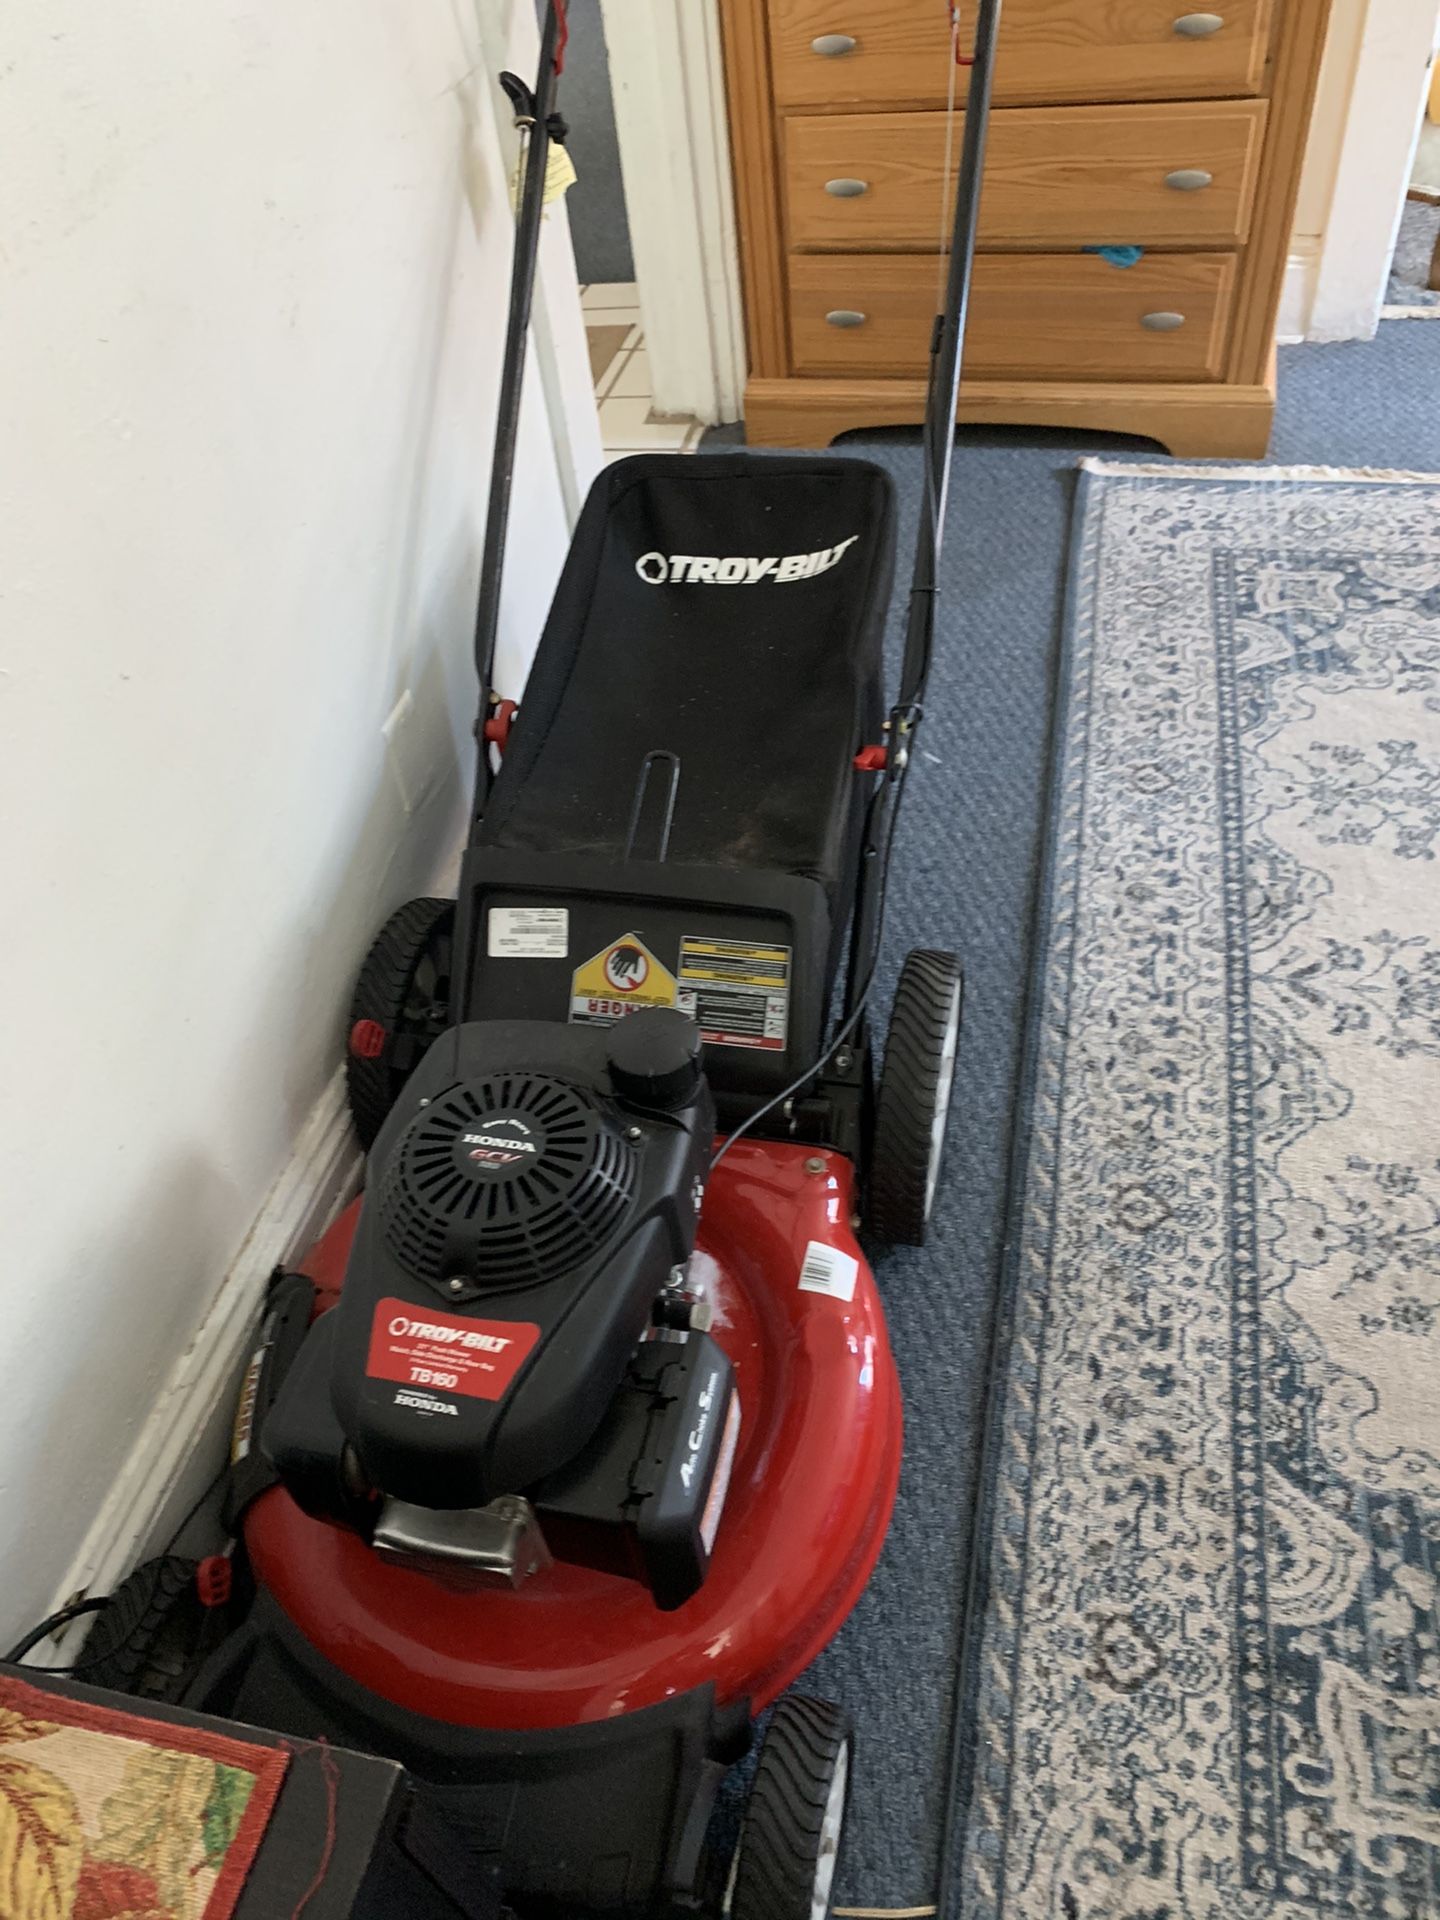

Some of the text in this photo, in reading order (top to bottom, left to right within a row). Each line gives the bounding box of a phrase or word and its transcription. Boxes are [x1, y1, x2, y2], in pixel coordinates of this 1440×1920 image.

[668, 535, 859, 584] TROY-BILT
[588, 999, 634, 1016] NGER
[461, 1133, 537, 1153] HONDA
[468, 1149, 525, 1164] GCV
[407, 1321, 515, 1354] TROY-BILT
[410, 1366, 460, 1389] TB160
[393, 1394, 460, 1416] HONDA
